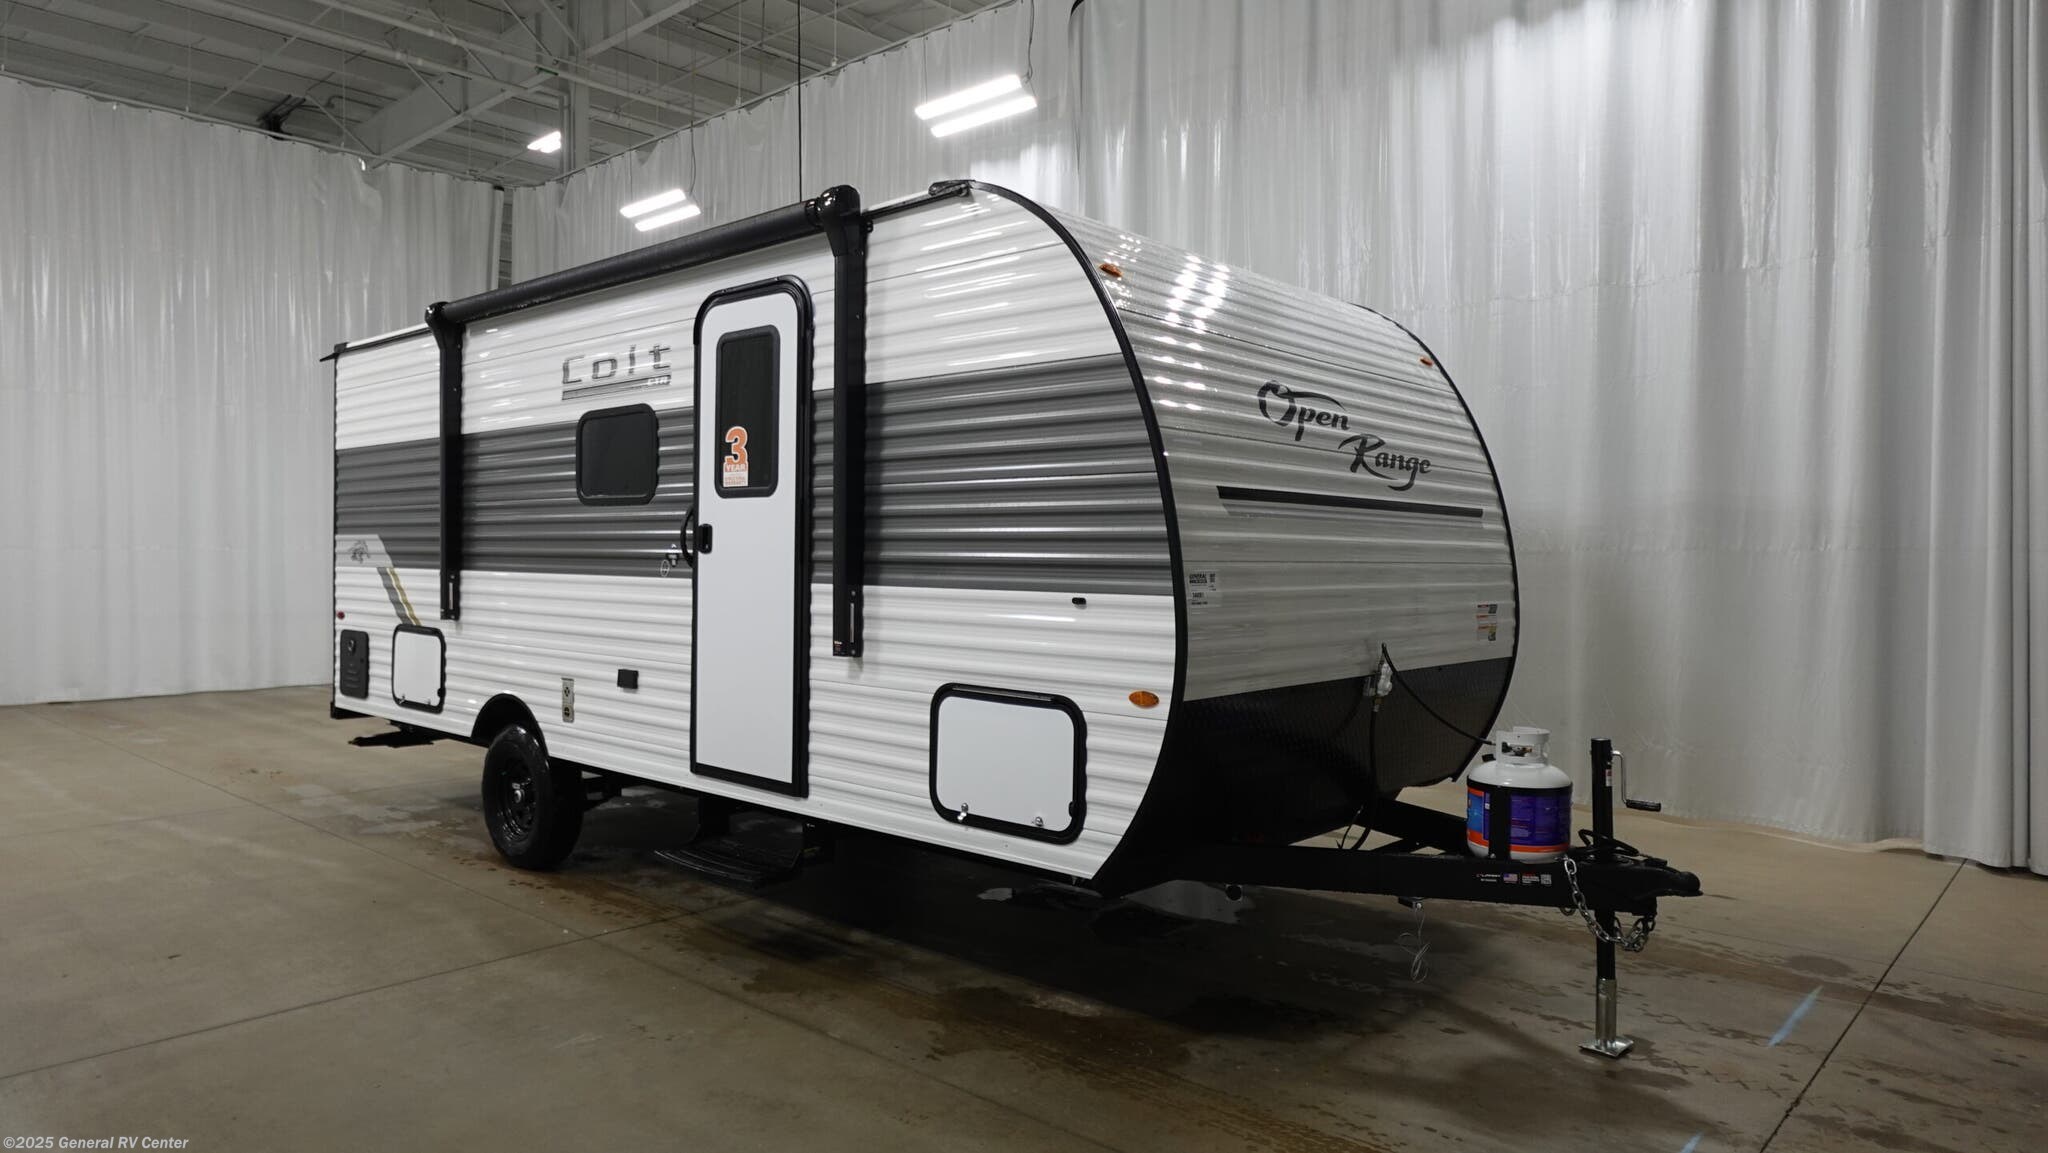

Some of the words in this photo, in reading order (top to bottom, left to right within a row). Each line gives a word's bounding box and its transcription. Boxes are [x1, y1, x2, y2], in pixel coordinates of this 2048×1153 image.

[562, 344, 671, 385] Colt
[1257, 380, 1350, 441] Open
[725, 425, 748, 465] 3
[1338, 433, 1432, 491] Range
